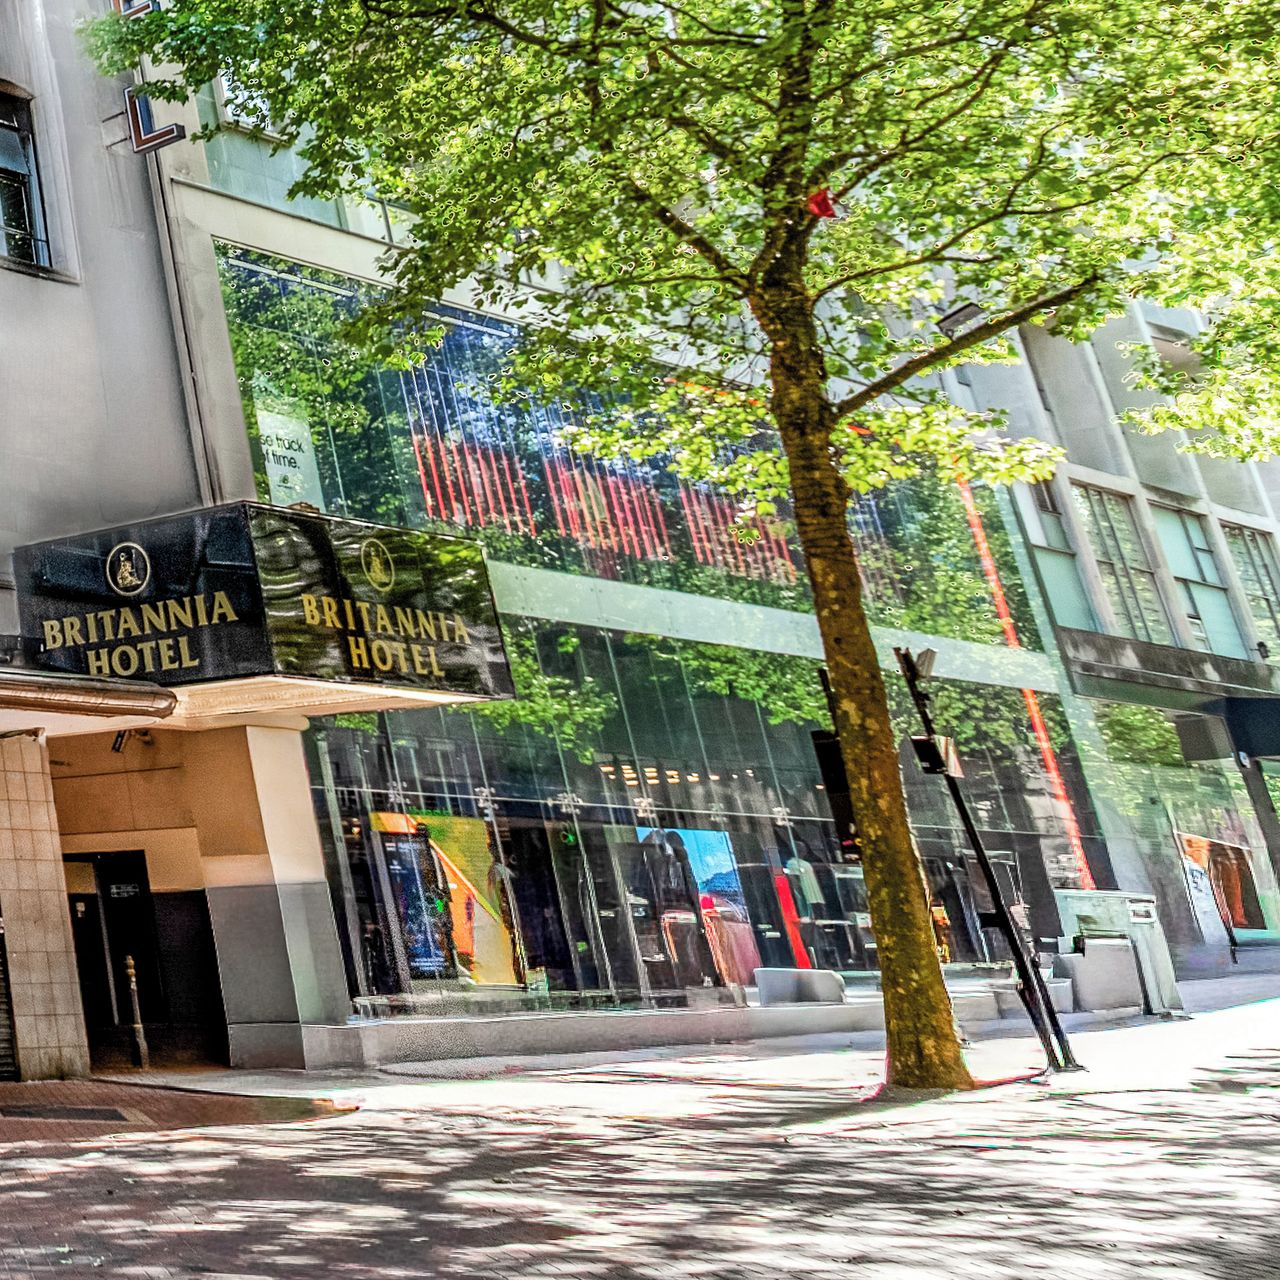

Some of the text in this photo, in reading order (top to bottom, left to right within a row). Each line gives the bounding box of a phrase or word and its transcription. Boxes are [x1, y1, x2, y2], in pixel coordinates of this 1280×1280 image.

[272, 451, 300, 470] time.
[276, 435, 304, 453] track
[42, 591, 239, 650] BRITANNIA
[301, 592, 472, 645] BRITANNIA
[86, 635, 200, 677] HOTEL
[347, 635, 446, 678] HOTEL
